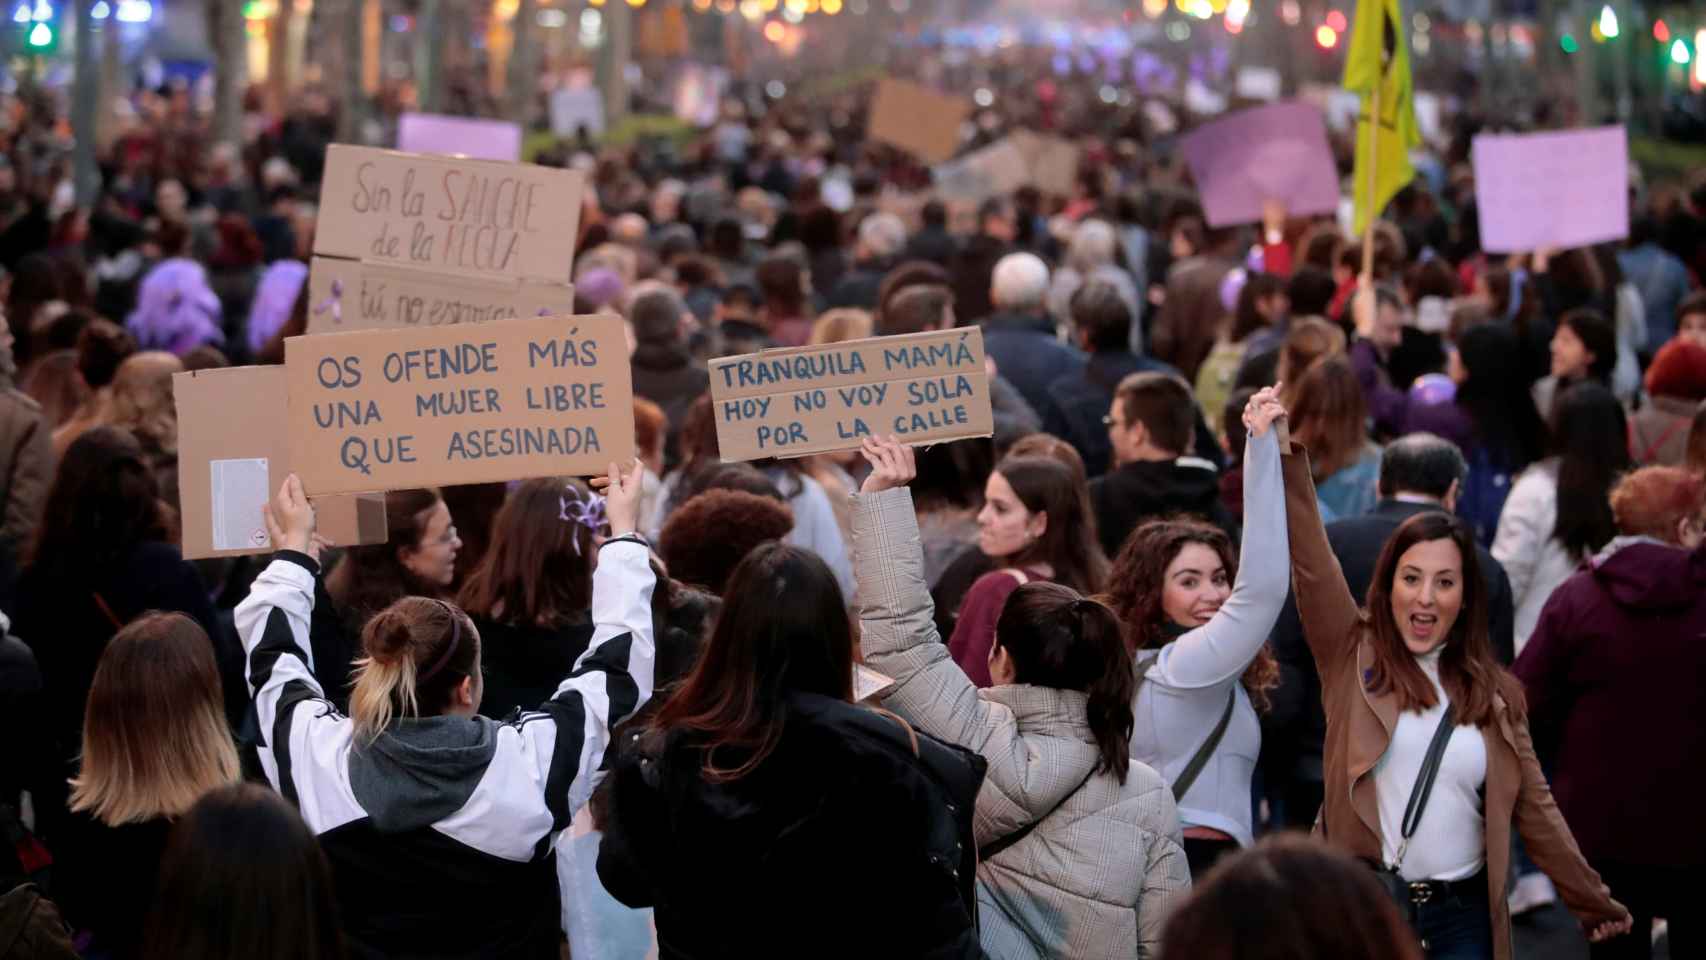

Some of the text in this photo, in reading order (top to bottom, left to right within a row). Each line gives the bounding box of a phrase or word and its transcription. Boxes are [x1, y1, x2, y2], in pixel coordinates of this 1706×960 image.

[352, 161, 391, 214] Sin
[400, 168, 425, 218] la
[371, 221, 400, 258] de
[410, 221, 434, 262] la
[397, 294, 424, 324] no
[317, 327, 598, 389] OS OFENDE MÁS
[717, 332, 975, 388] TRANQUILA MAMÁ
[313, 383, 606, 428] UNA MUJER LIBRE
[724, 375, 973, 422] HOY NO VOY SOLA
[757, 405, 968, 448] POR LA CALLE
[340, 426, 601, 475] QUE ASESINADA
